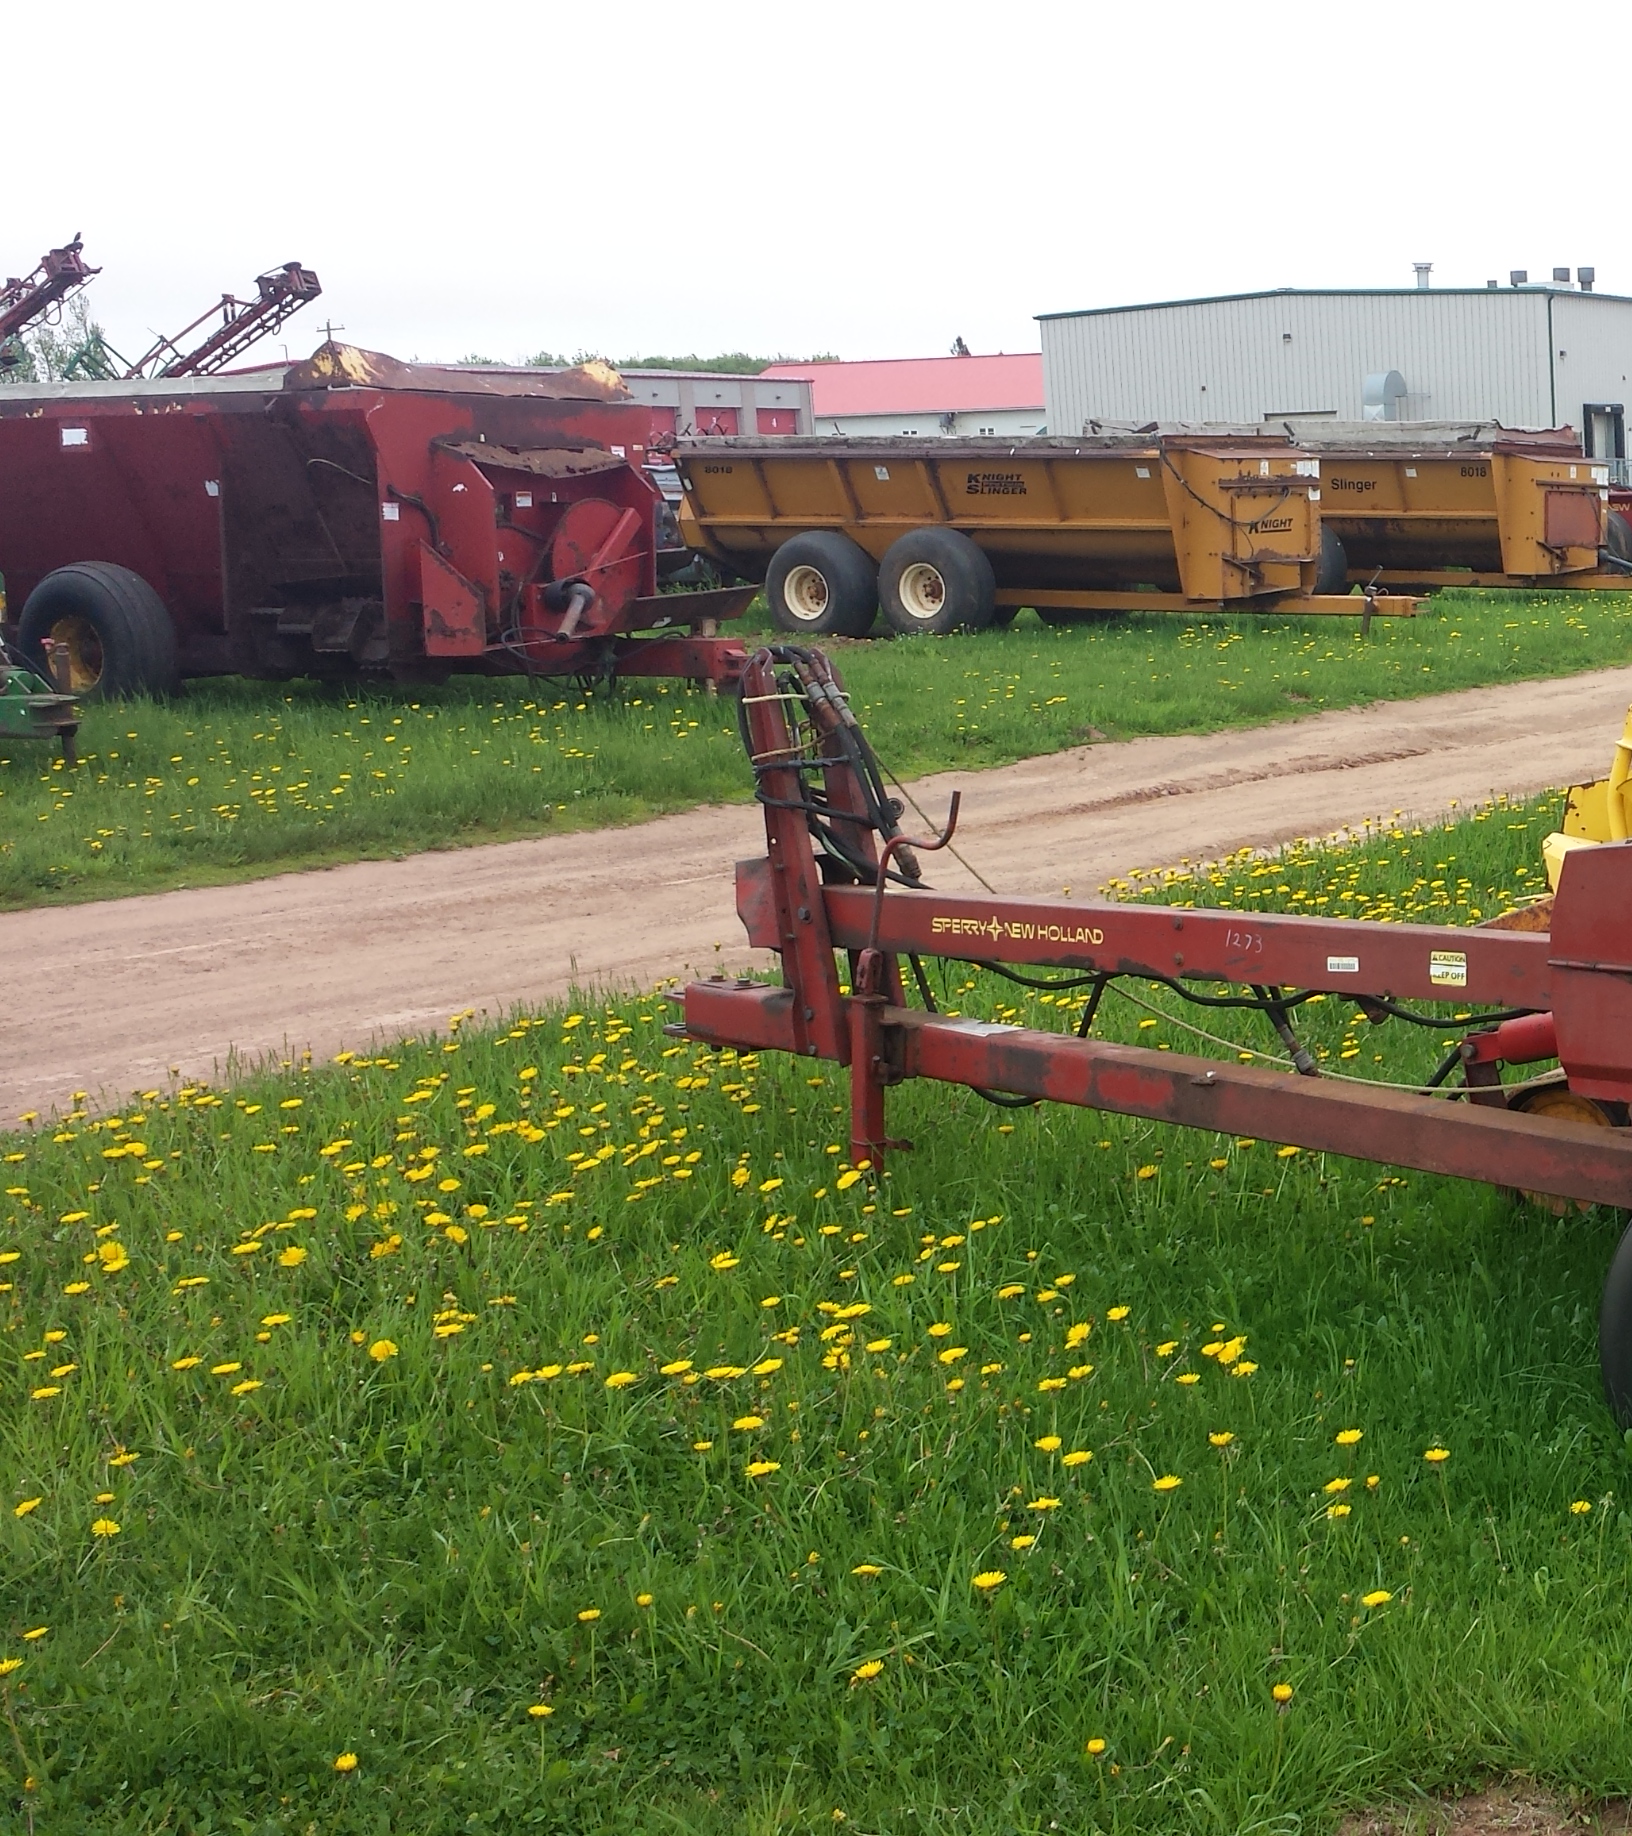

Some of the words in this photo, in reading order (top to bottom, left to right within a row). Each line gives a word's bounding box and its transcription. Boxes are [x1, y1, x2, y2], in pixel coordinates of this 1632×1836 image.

[1460, 466, 1487, 477] 8018
[967, 473, 1022, 484] KNIGHT
[1331, 478, 1377, 492] Slinger
[966, 482, 1027, 495] SLINGER
[931, 917, 987, 936] SPERRY
[1004, 922, 1035, 940] NEW
[1037, 925, 1104, 945] HOLLAND
[1225, 929, 1263, 953] 1273
[1451, 972, 1465, 980] OFF
